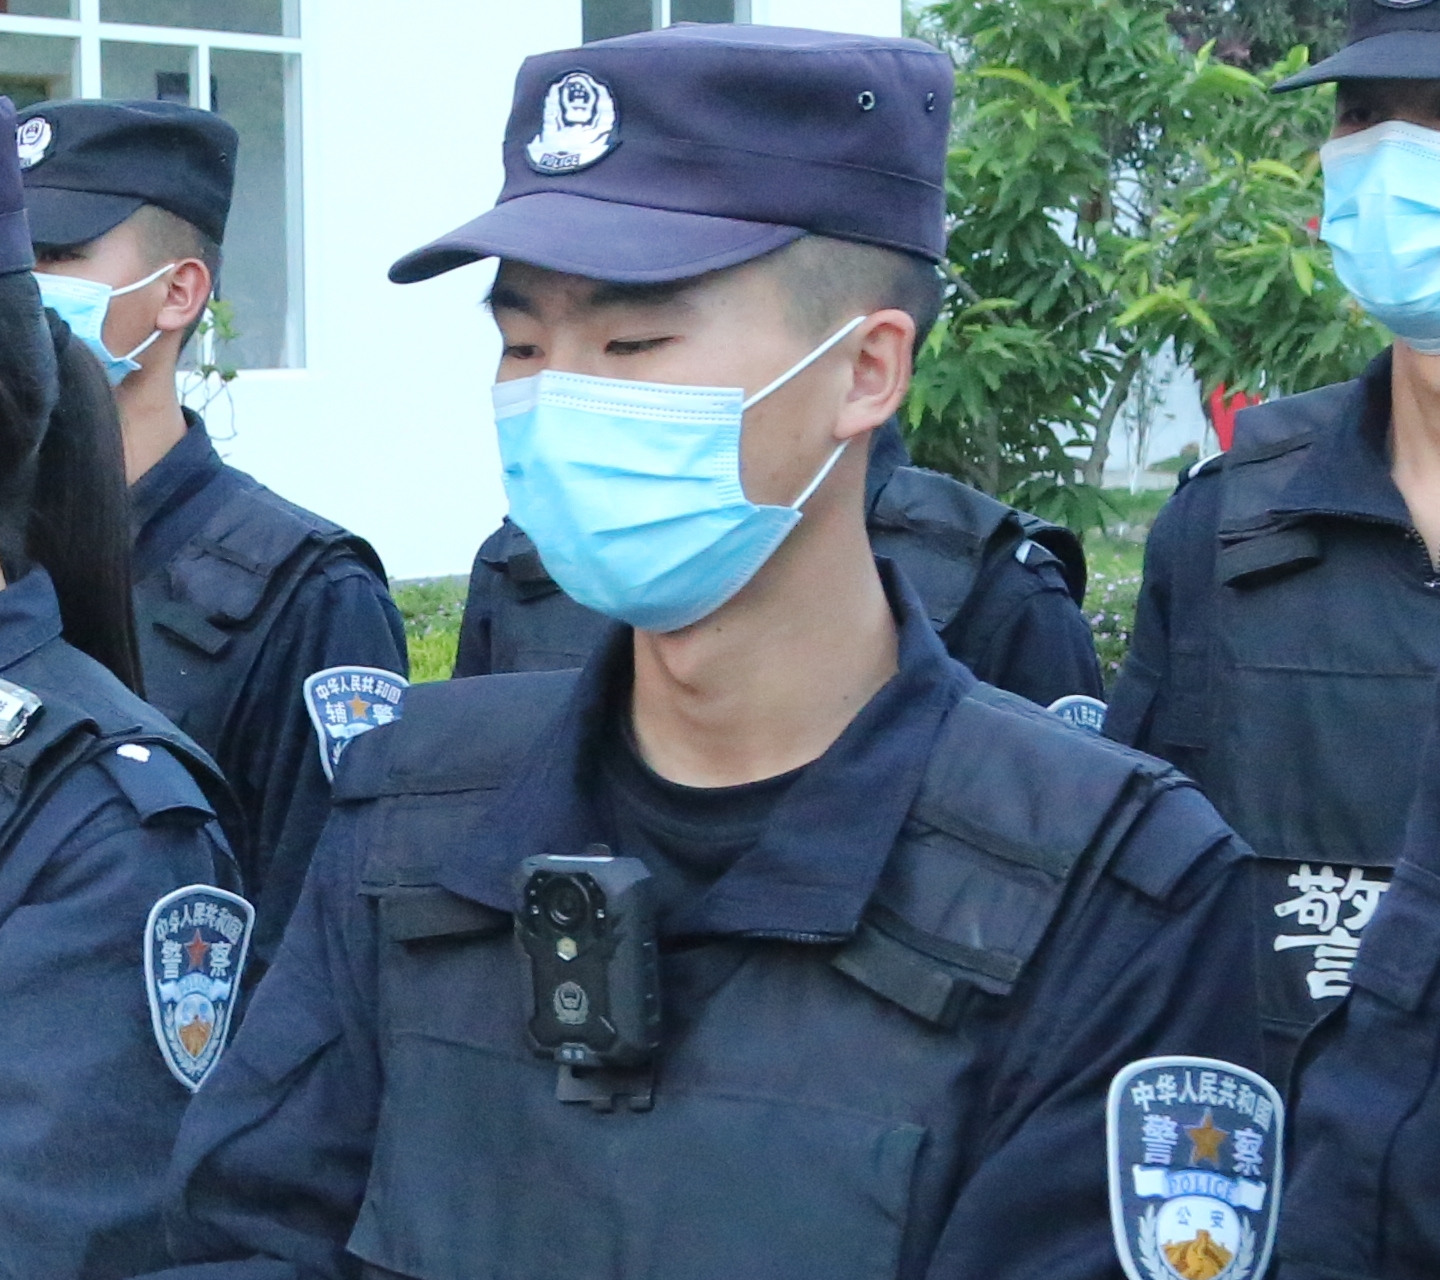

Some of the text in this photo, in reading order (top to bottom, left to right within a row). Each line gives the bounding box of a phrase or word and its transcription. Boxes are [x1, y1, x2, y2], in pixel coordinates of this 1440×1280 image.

[315, 674, 402, 705] 中华人民共和国
[155, 901, 245, 946] 中华人民共和国
[1130, 1071, 1274, 1133] 中华人民共和国
[1169, 1171, 1234, 1201] POLICE
